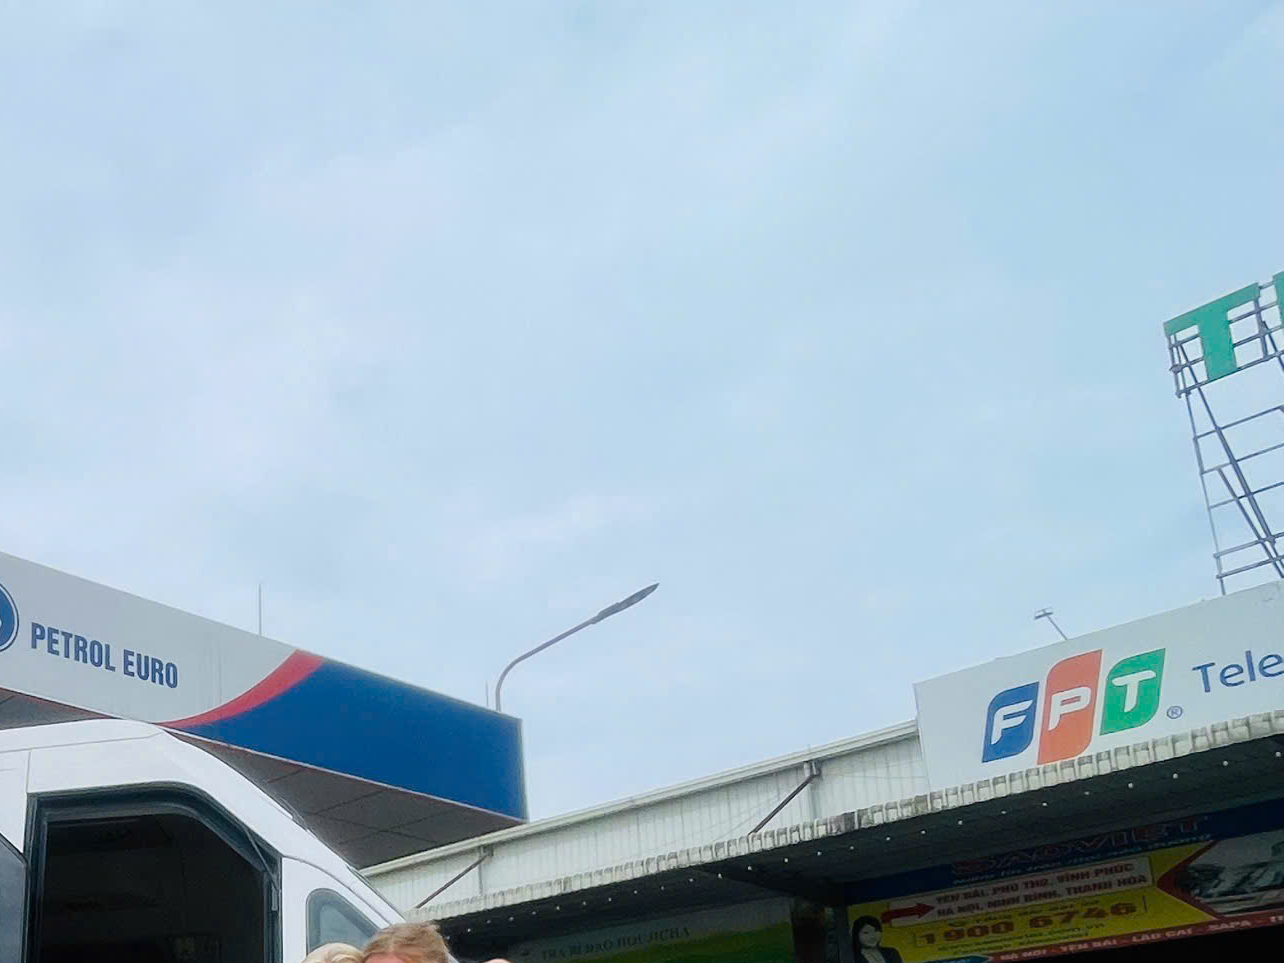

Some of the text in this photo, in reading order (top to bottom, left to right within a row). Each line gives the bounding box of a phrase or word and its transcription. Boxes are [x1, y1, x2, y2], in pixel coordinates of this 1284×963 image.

[31, 622, 178, 689] PETROL EURO
[986, 660, 1161, 755] FPT
[924, 921, 1014, 944] 1900
